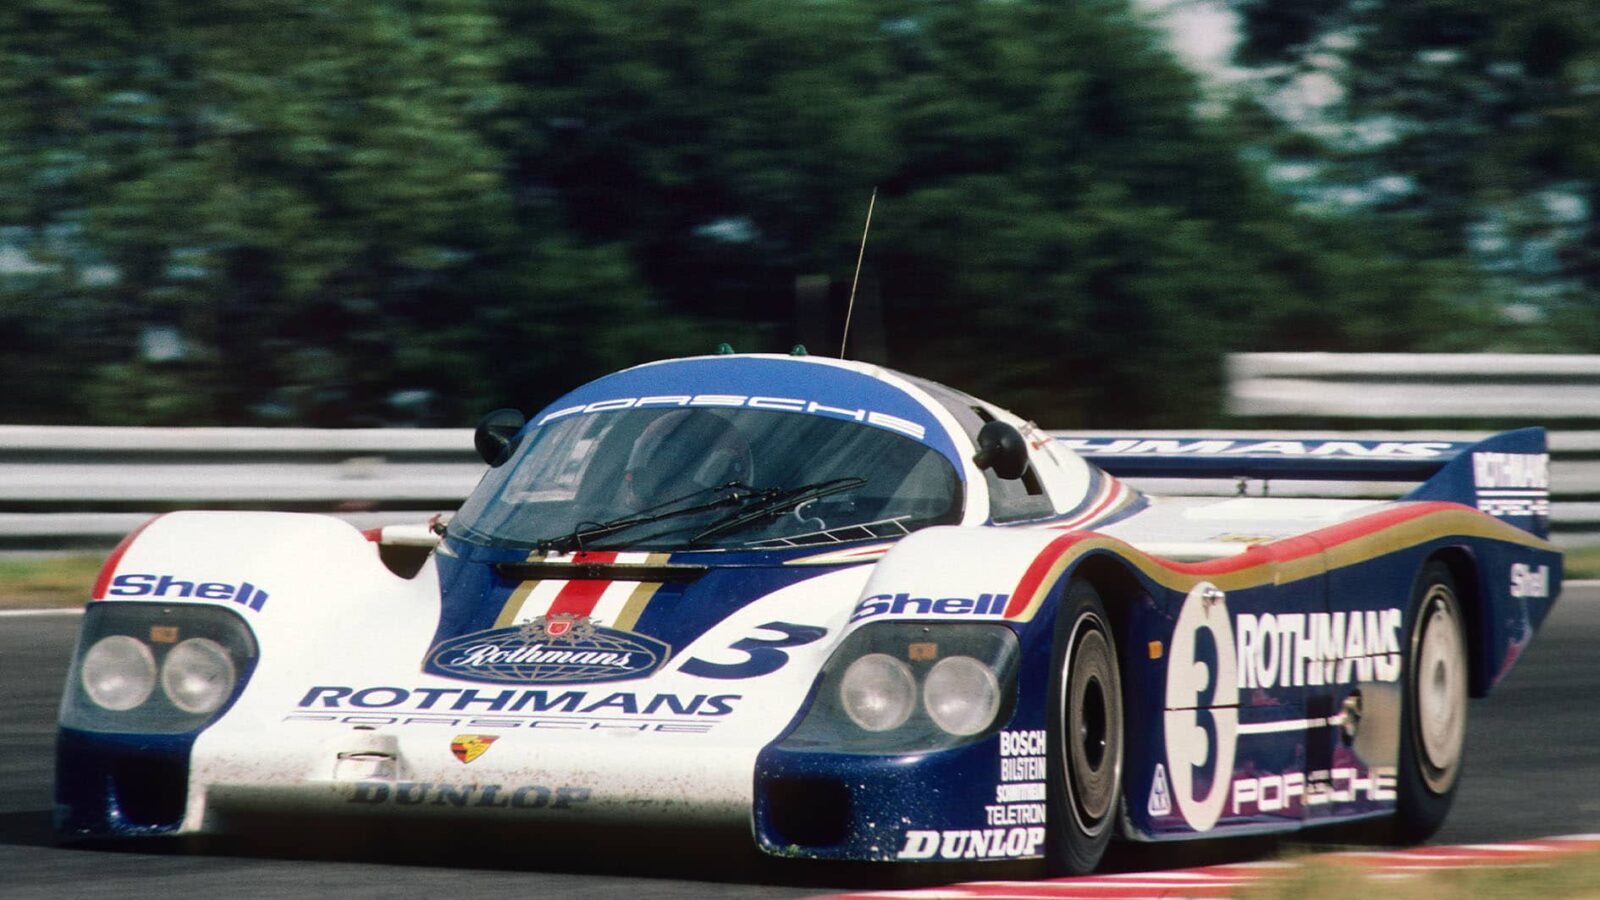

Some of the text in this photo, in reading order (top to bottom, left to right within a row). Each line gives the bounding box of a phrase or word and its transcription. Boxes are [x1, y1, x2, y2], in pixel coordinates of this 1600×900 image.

[537, 394, 926, 439] PORSCHE
[109, 574, 269, 613] Shell
[1510, 563, 1549, 598] Shell
[850, 593, 1009, 623] Shell
[450, 642, 635, 670] Rothmans
[676, 621, 828, 680] 3
[1236, 608, 1402, 689] ROTHMANS
[298, 686, 742, 716] ROTHMANS
[1191, 625, 1219, 804] 3
[282, 715, 715, 734] PORSCHE
[999, 730, 1047, 757] BOSCH
[1000, 757, 1047, 782] BILSTEIN
[348, 782, 592, 810] DUNLOP
[1233, 766, 1397, 815] PORSCHE
[984, 804, 1047, 826] TELETRON
[896, 827, 1046, 860] DUNLOP
